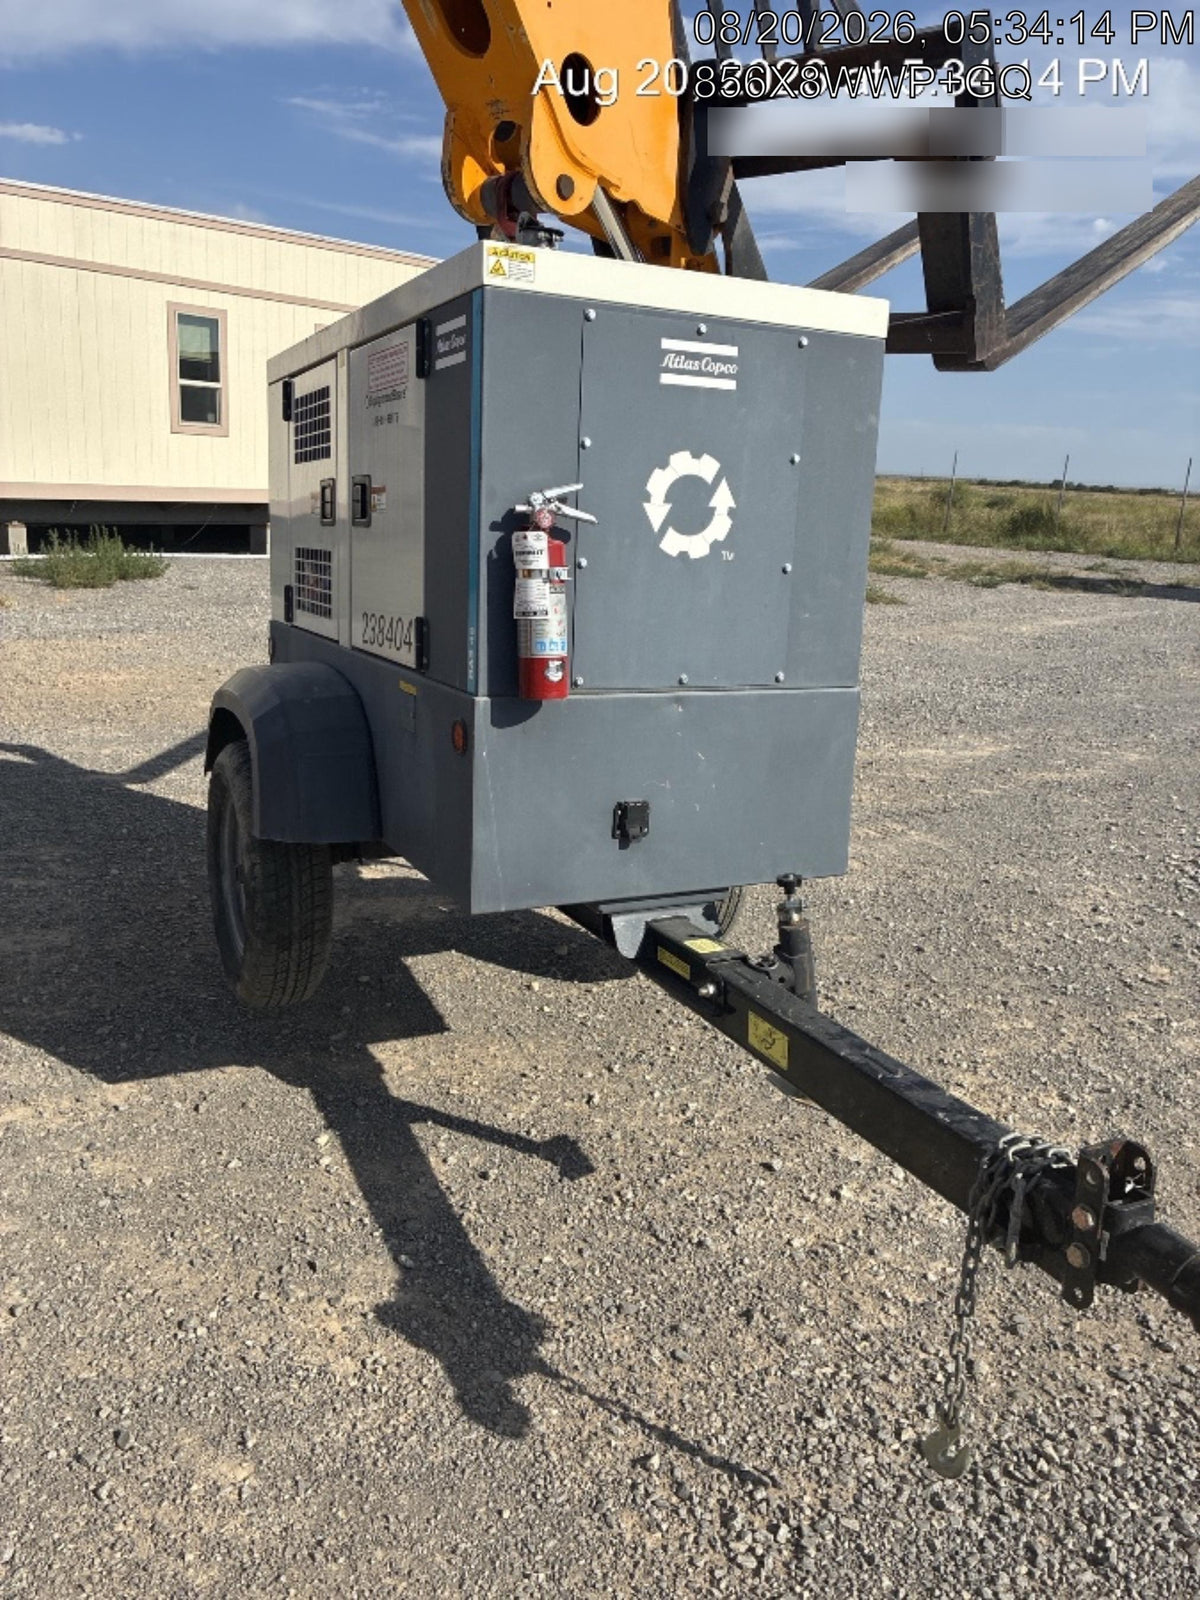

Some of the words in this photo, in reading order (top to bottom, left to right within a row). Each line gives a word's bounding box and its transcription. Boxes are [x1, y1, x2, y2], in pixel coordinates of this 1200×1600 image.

[660, 353, 700, 371] Atlas
[701, 356, 738, 376] Copco
[362, 611, 413, 653] 238404
